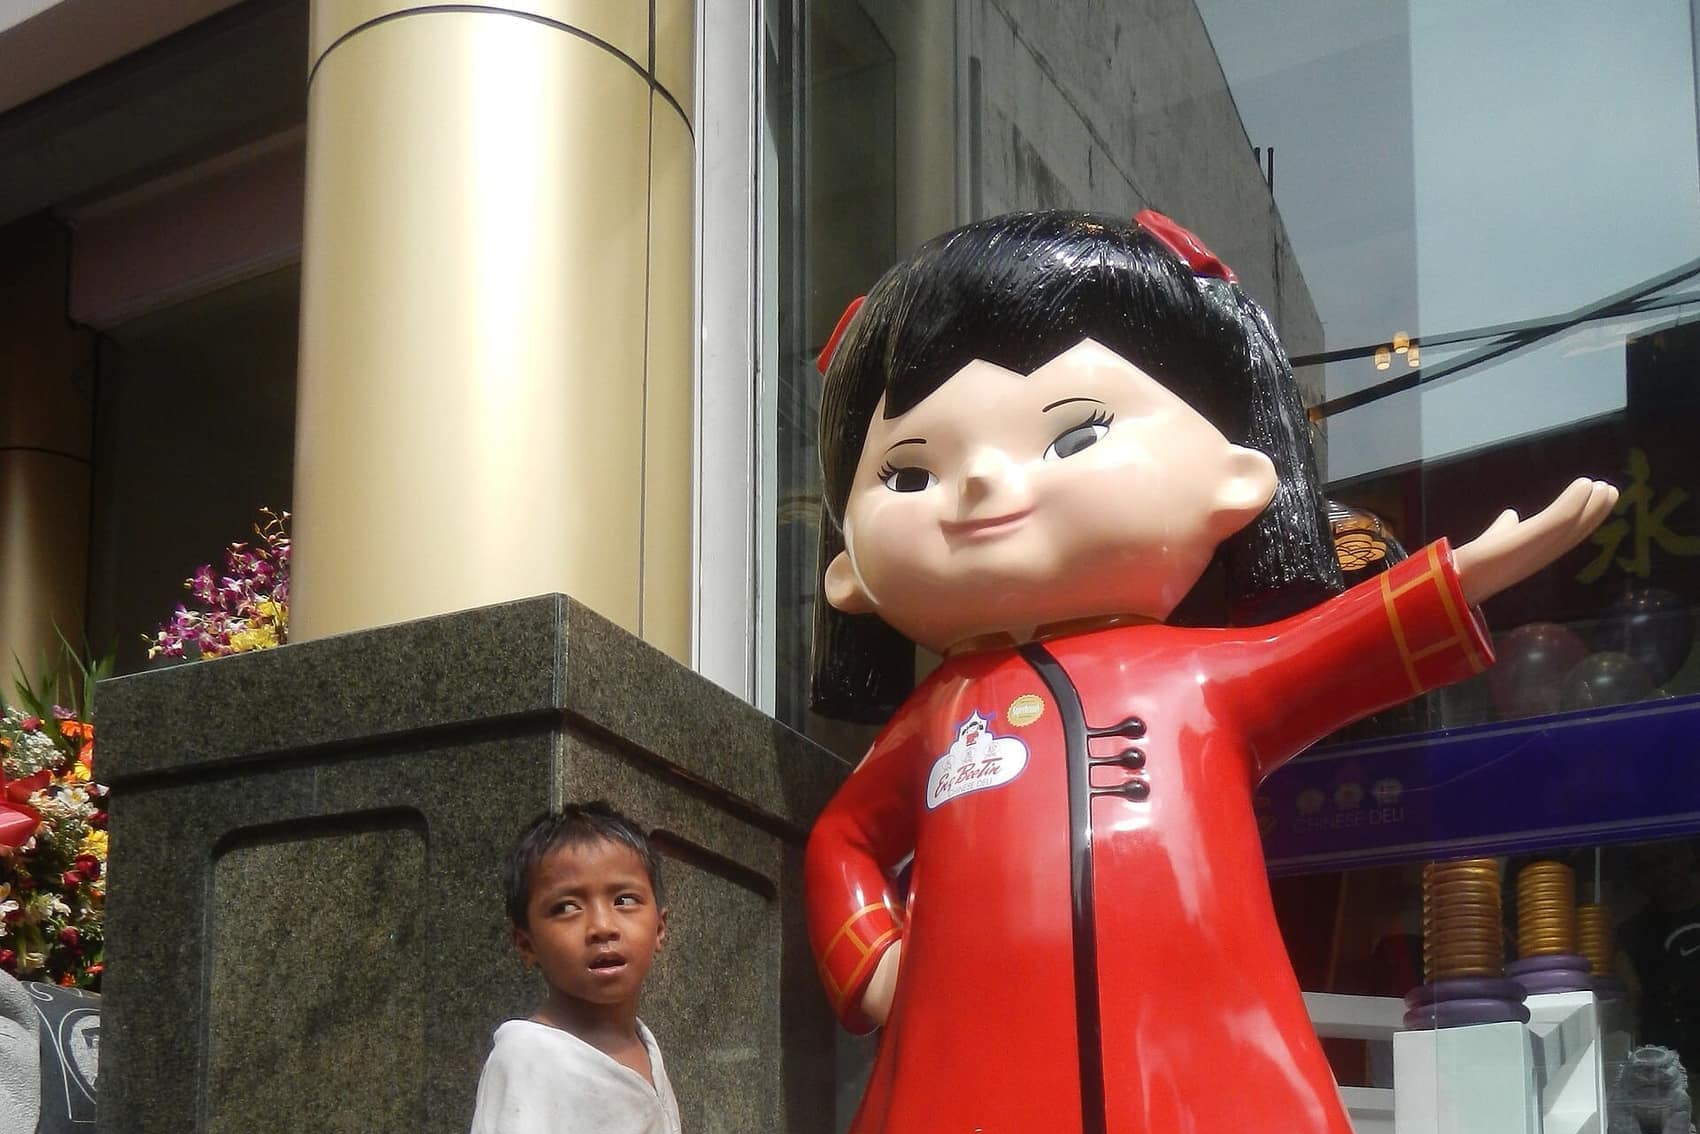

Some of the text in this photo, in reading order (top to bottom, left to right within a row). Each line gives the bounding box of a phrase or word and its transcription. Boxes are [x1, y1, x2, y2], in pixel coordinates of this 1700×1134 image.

[1574, 447, 1700, 584] 永
[976, 757, 1003, 777] Tin
[1368, 807, 1405, 825] DELI
